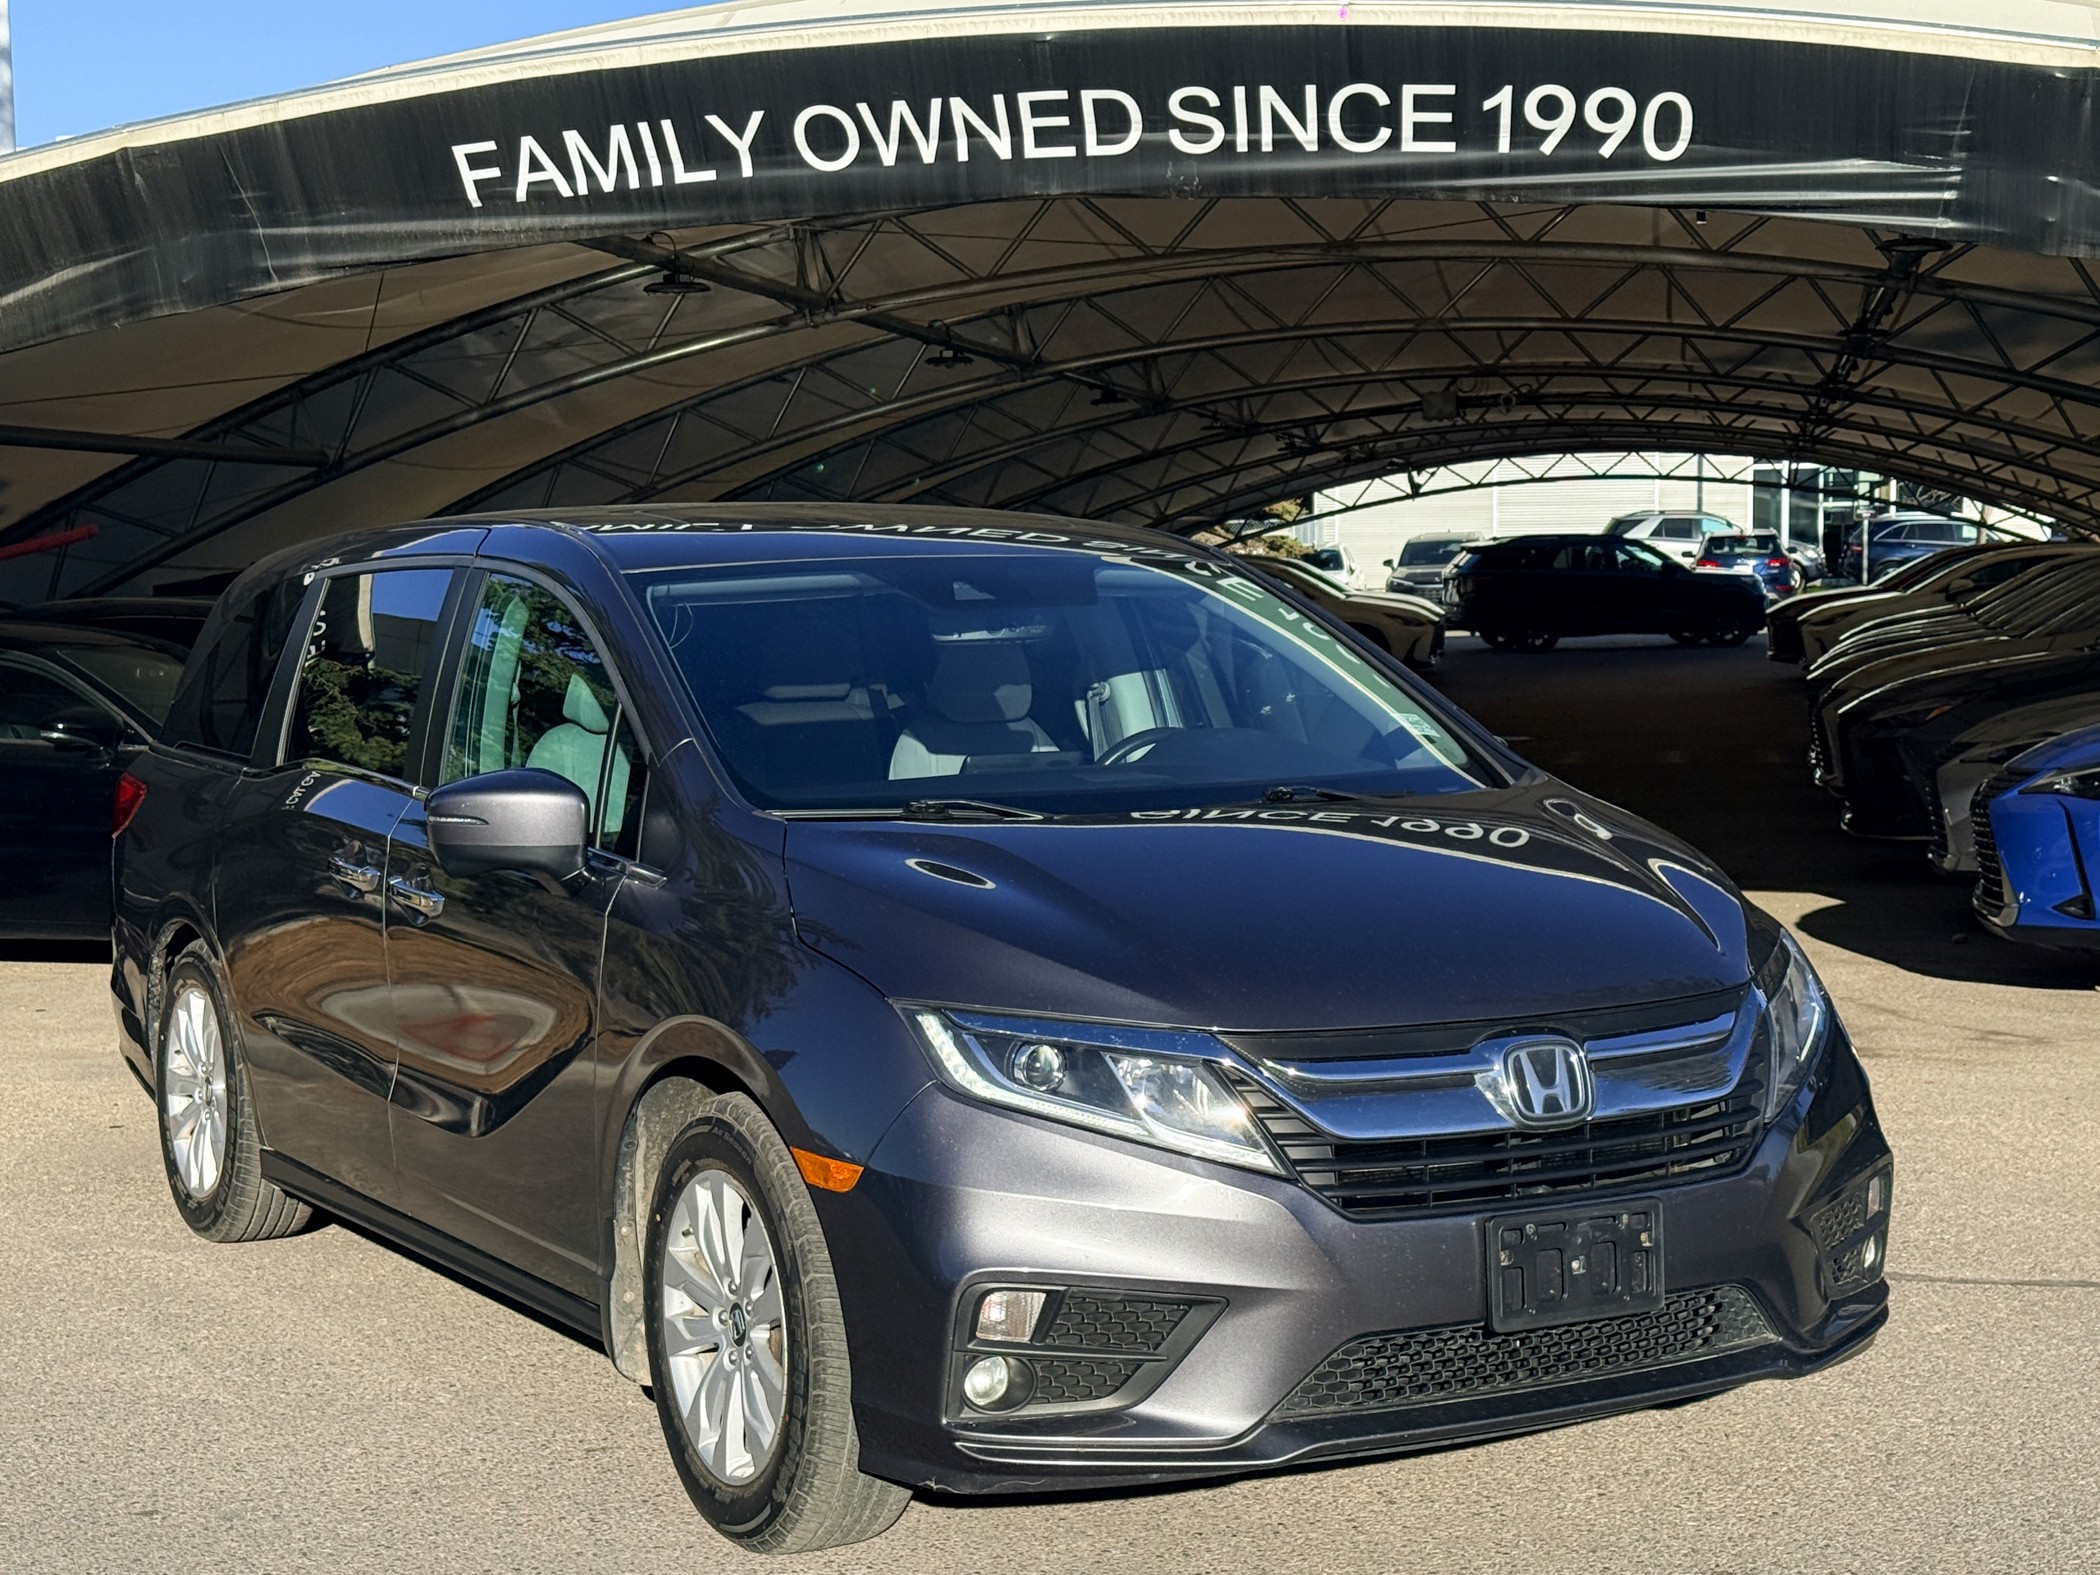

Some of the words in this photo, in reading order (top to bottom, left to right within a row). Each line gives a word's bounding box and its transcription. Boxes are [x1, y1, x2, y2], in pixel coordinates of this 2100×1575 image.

[451, 110, 765, 208] FAMILY
[793, 88, 1144, 172] OWNED
[1168, 83, 1458, 154] SINCE
[1482, 84, 1694, 162] 1990
